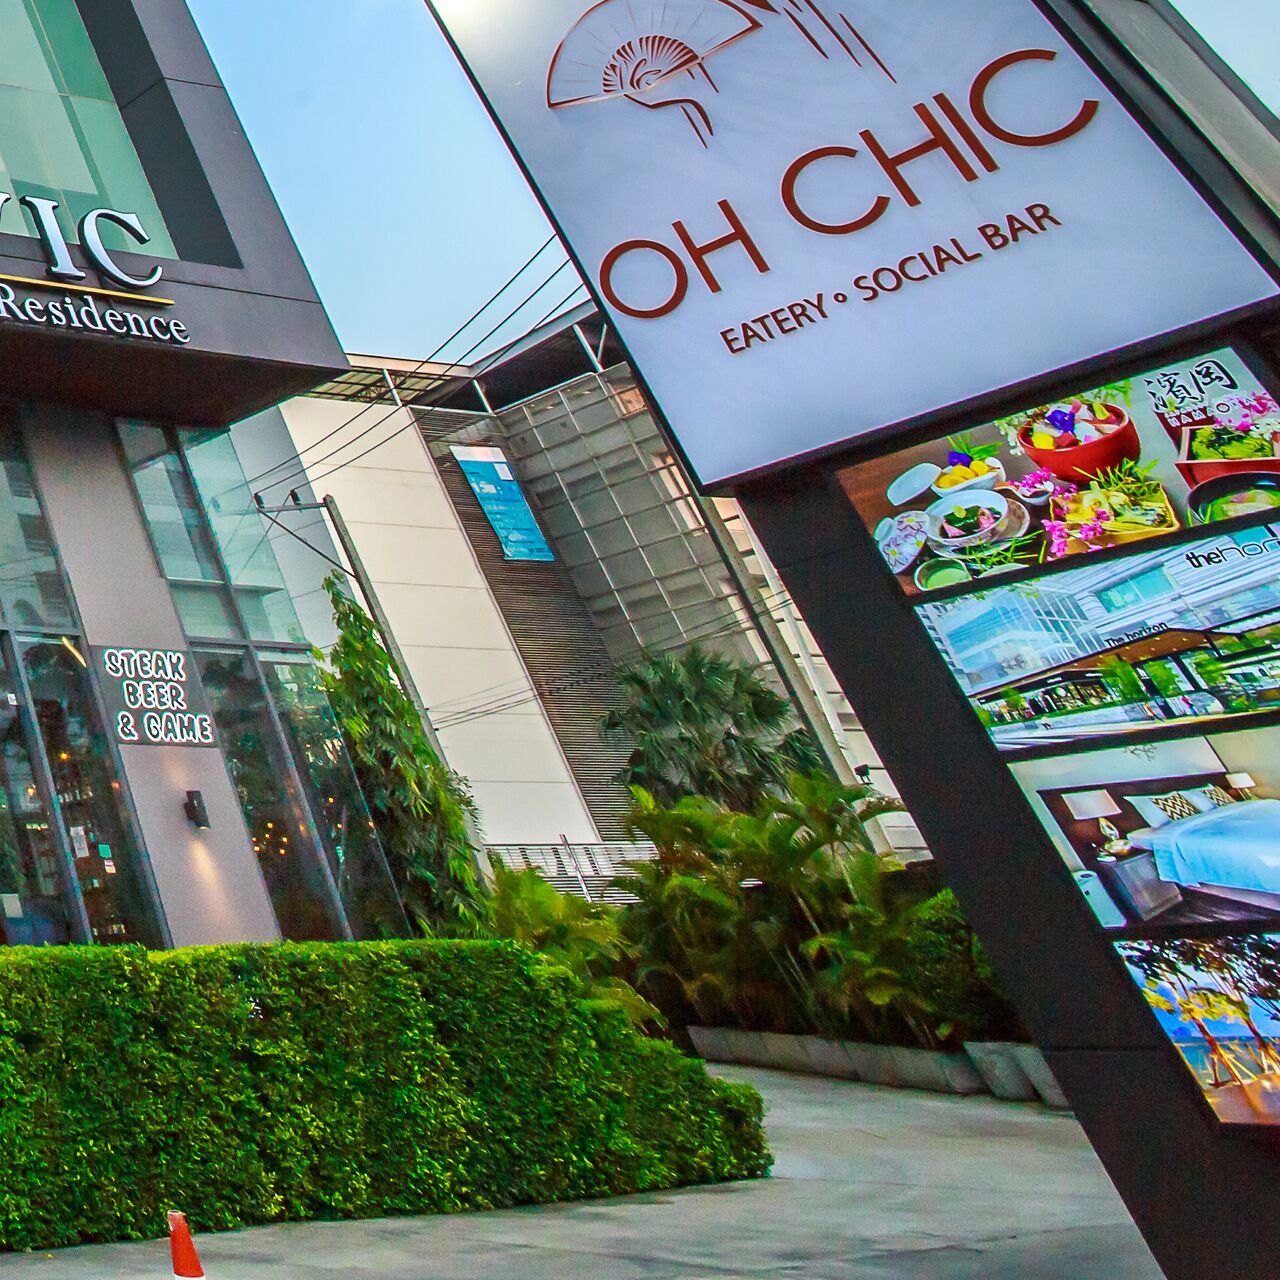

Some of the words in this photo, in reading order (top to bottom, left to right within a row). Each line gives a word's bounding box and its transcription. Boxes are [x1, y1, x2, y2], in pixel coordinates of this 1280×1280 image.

[598, 198, 772, 319] OH
[780, 48, 1100, 235] CHIC
[719, 292, 829, 355] EATERY
[853, 237, 983, 302] SOCIAL
[977, 202, 1063, 251] BAR
[1126, 621, 1169, 641] horizon
[104, 648, 187, 682] STEAK
[122, 679, 188, 711] BEER
[117, 710, 140, 741] &
[144, 711, 215, 744] GAME
